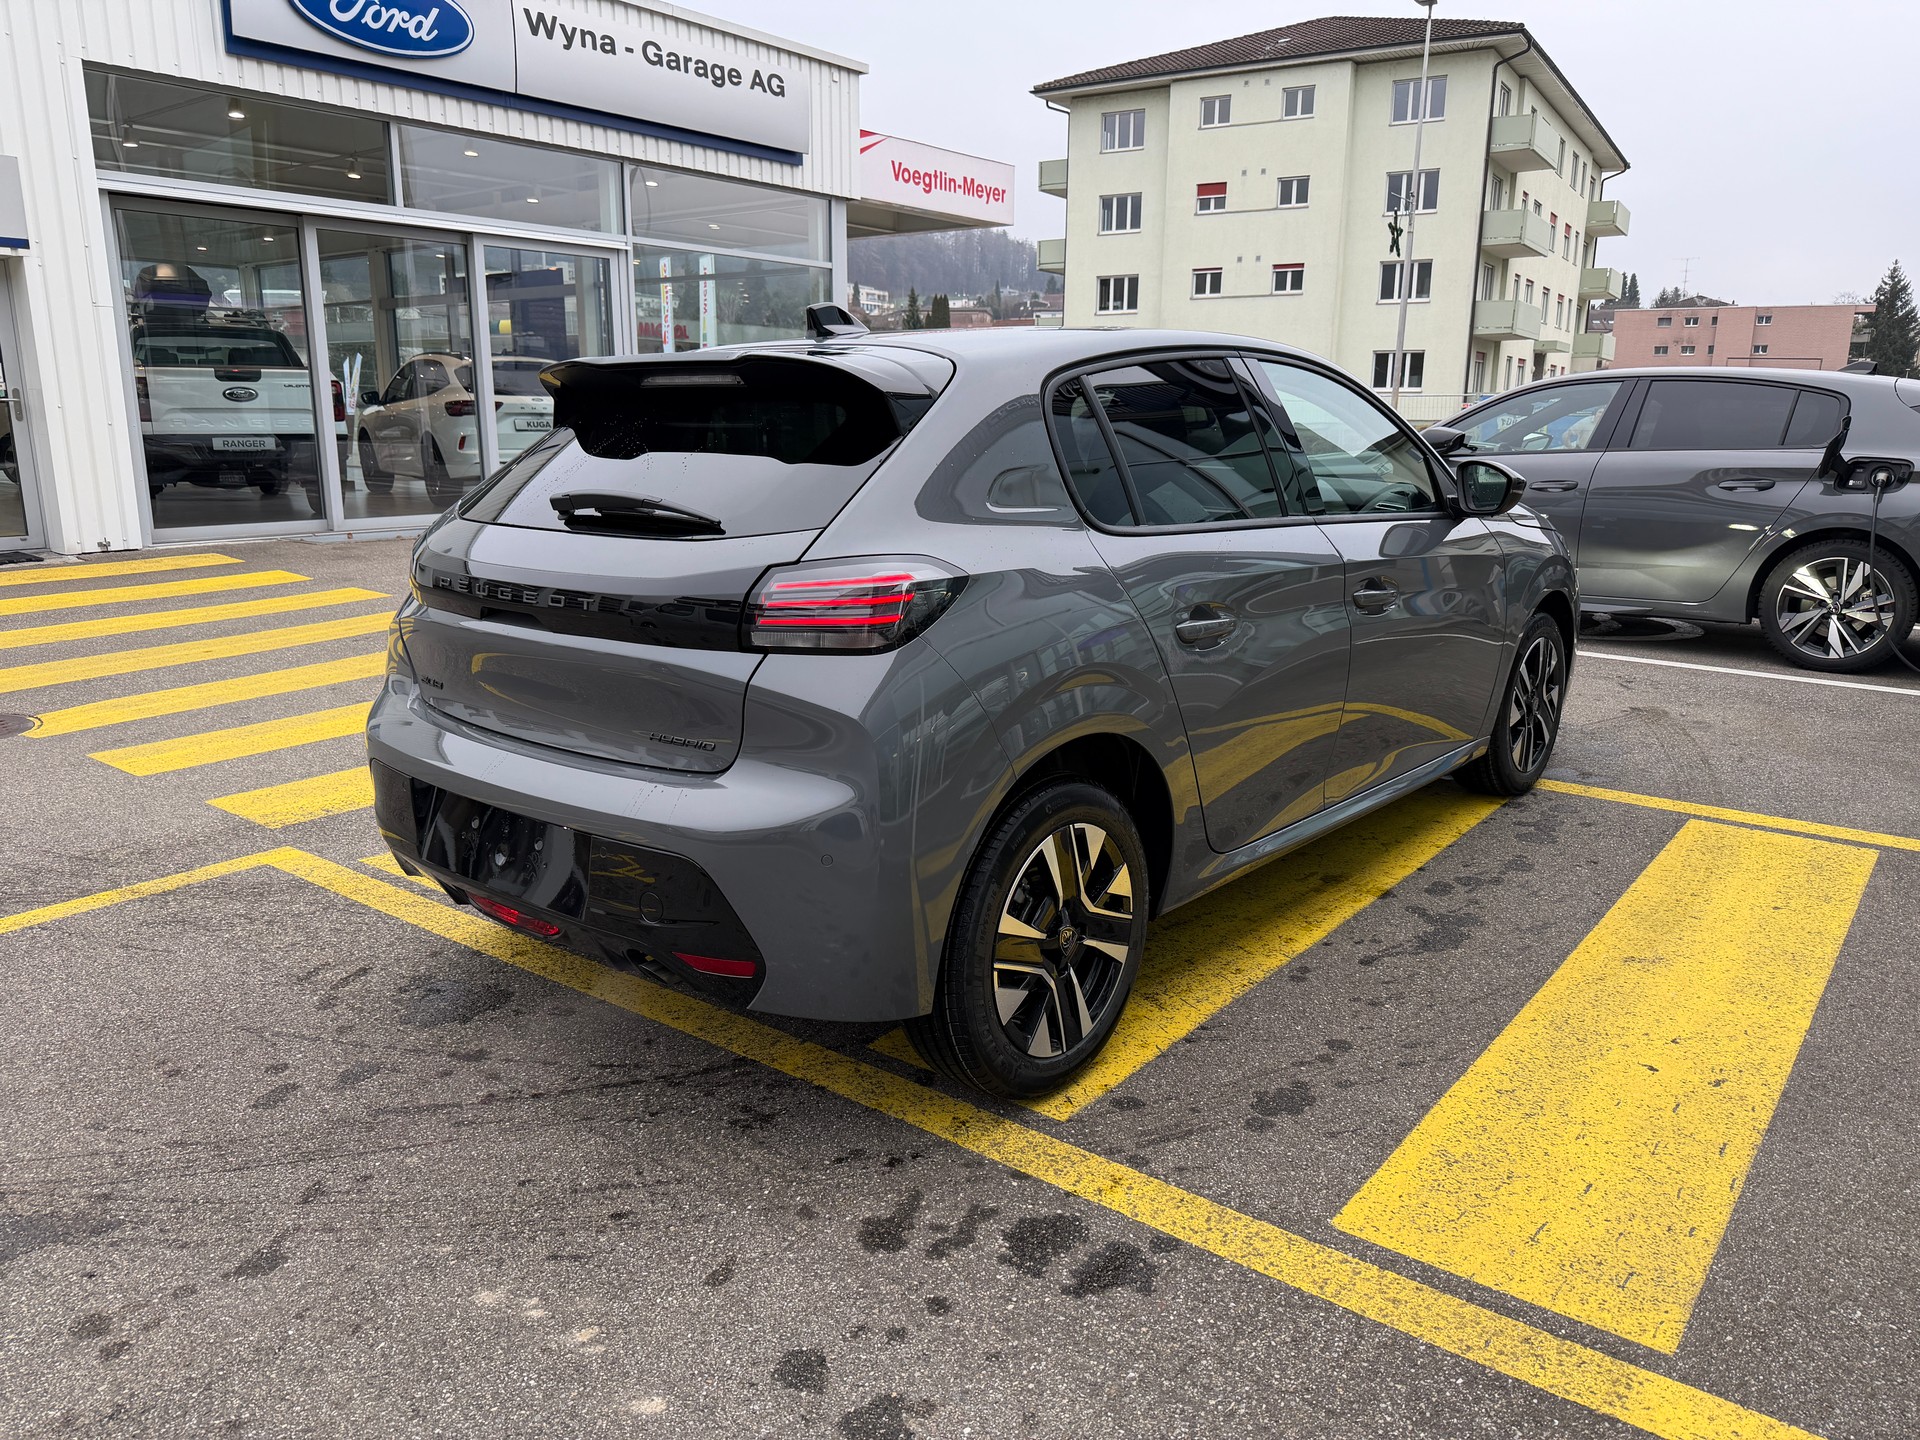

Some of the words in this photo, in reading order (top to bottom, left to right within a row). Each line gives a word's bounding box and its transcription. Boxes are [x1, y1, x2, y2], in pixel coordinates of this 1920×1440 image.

[523, 7, 617, 56] Wyna
[641, 40, 742, 88] Garage
[749, 69, 786, 98] AG
[891, 160, 1006, 204] Voegtlin-Meyer
[638, 322, 689, 339] MIGOL
[222, 439, 266, 448] RANGER
[439, 576, 595, 611] PEUGEOT
[649, 732, 716, 751] HYBRID
